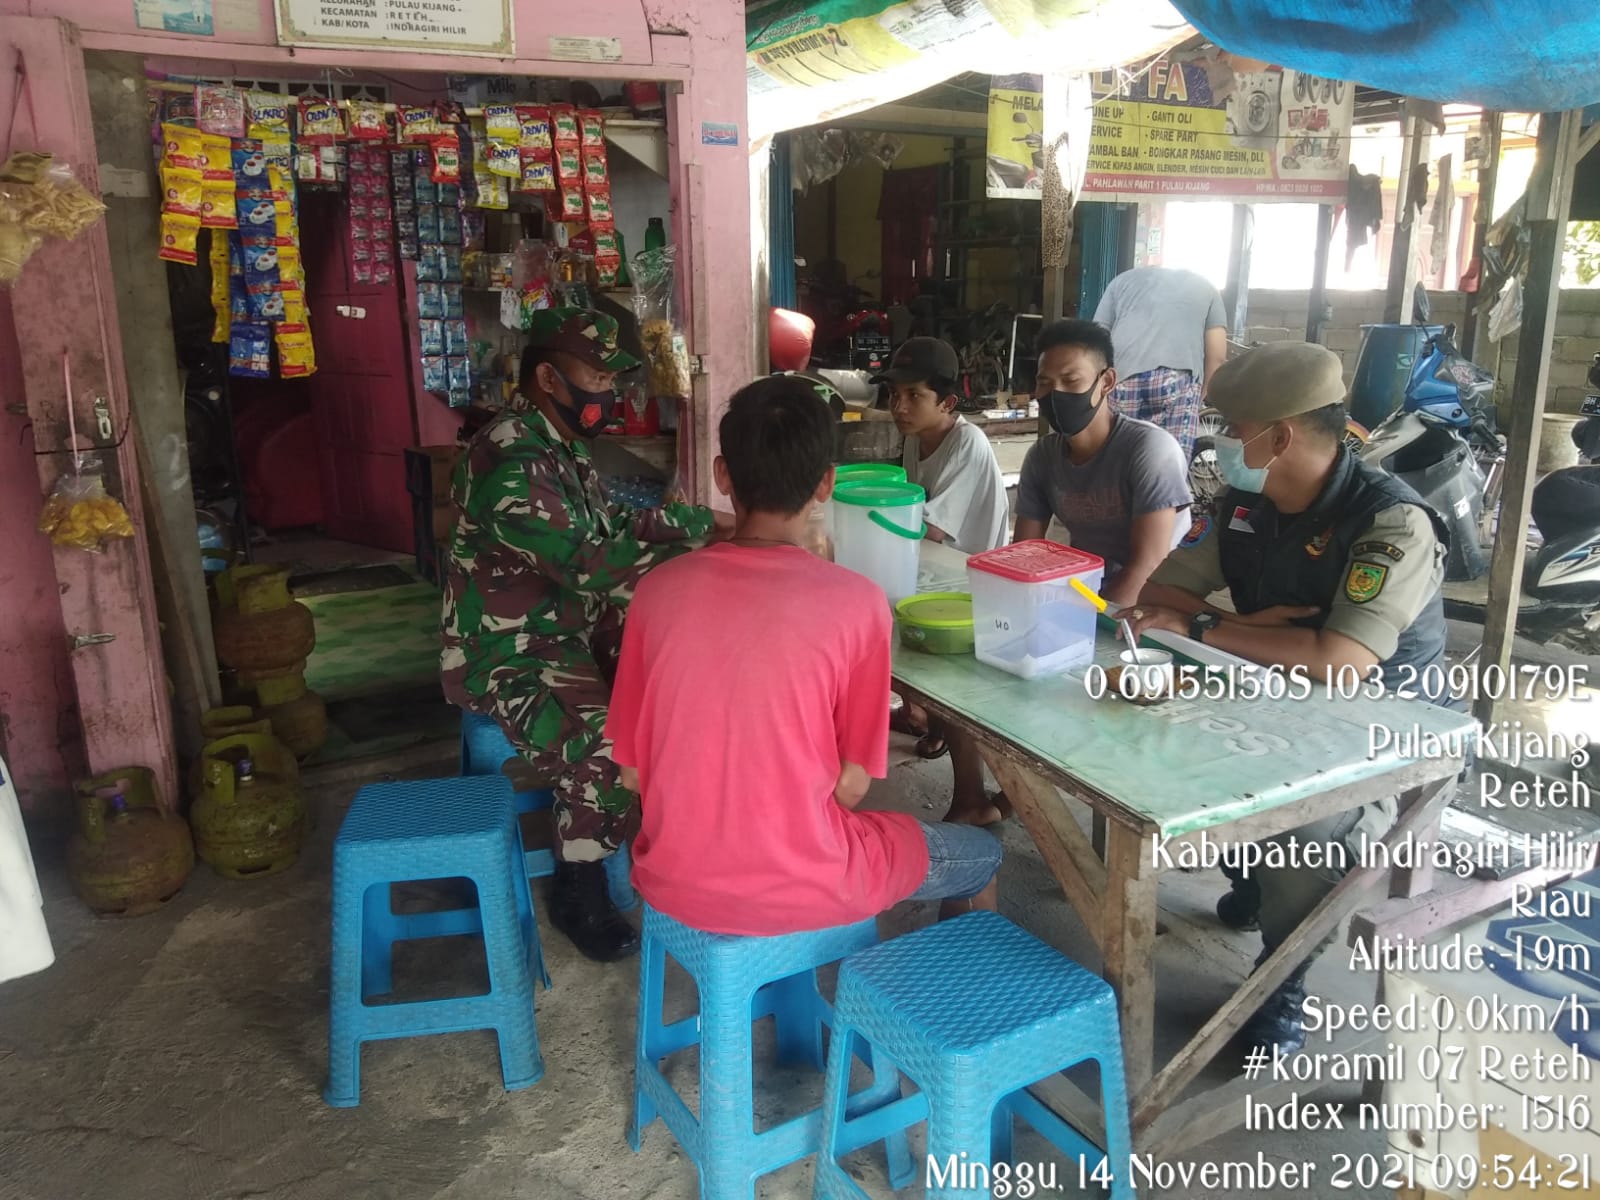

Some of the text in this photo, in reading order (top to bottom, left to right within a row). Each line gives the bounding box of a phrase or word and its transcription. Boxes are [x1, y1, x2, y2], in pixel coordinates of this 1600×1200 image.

[321, 7, 377, 18] KECAMATAN
[422, 3, 456, 13] KIJANG
[346, 20, 370, 29] KOTA
[442, 26, 467, 35] HILIR
[1012, 95, 1043, 111] MELA
[1092, 105, 1110, 118] UNE
[1151, 111, 1193, 124] GANTI OLI
[1091, 125, 1123, 138] ERVICE
[1150, 129, 1199, 143] SPARE PART
[1089, 144, 1139, 158] AMBAL BAN
[1148, 147, 1189, 160] BONGKAR
[1190, 149, 1222, 161] PASANG
[1250, 152, 1265, 163] DLL
[1087, 159, 1112, 169] ERVICE
[1135, 180, 1154, 190] PARIT
